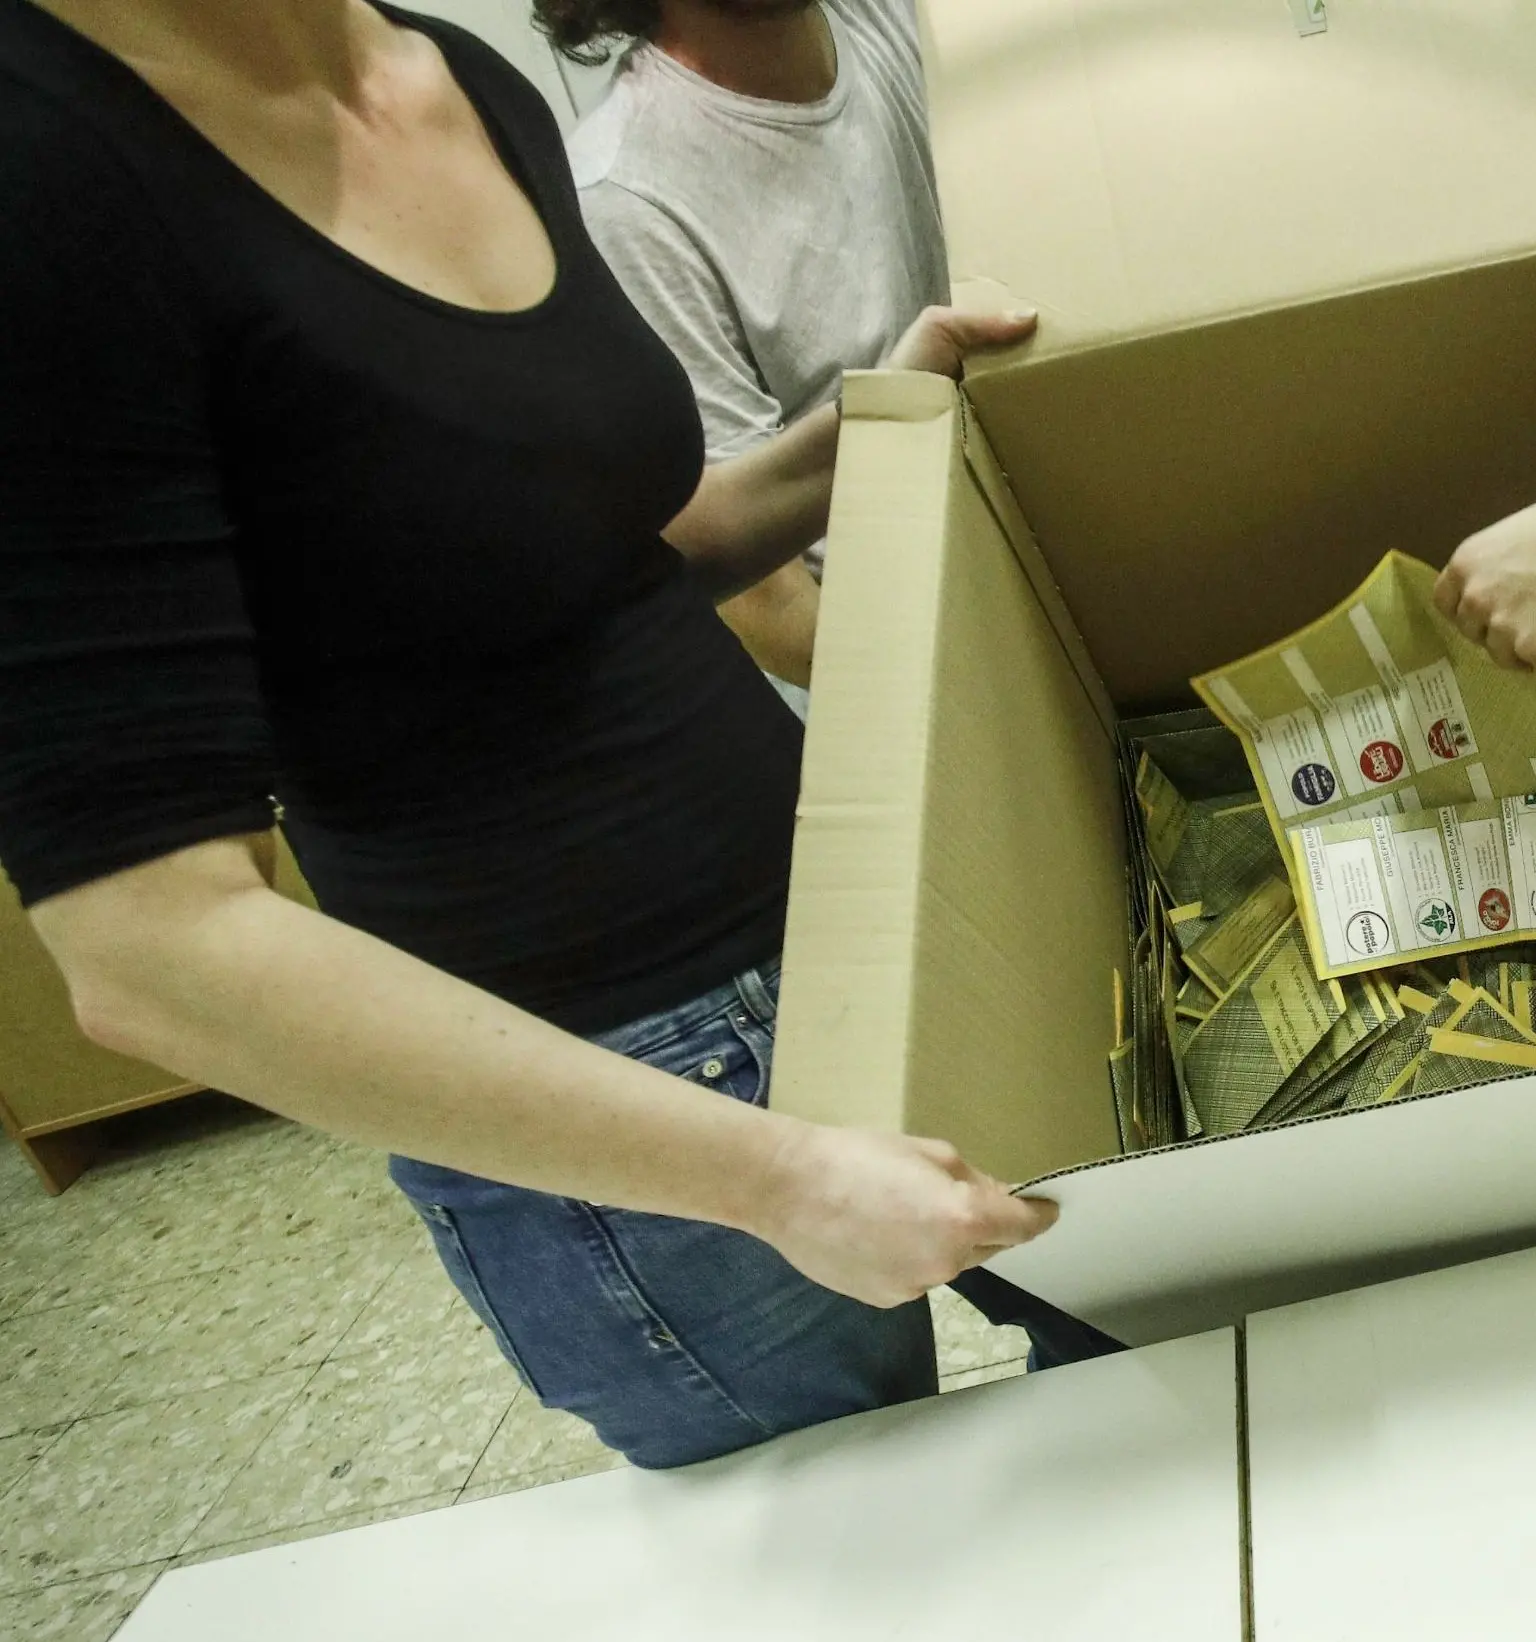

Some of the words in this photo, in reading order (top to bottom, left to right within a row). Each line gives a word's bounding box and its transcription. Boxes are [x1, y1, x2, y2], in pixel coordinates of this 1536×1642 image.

[1442, 809, 1455, 838] MARIA
[1505, 820, 1516, 847] EMMA
[1309, 851, 1324, 891] FABRIZIO
[1380, 832, 1394, 877] GIUSEPPE
[1449, 838, 1465, 891] FRANCESCA
[1362, 925, 1375, 954] potere
